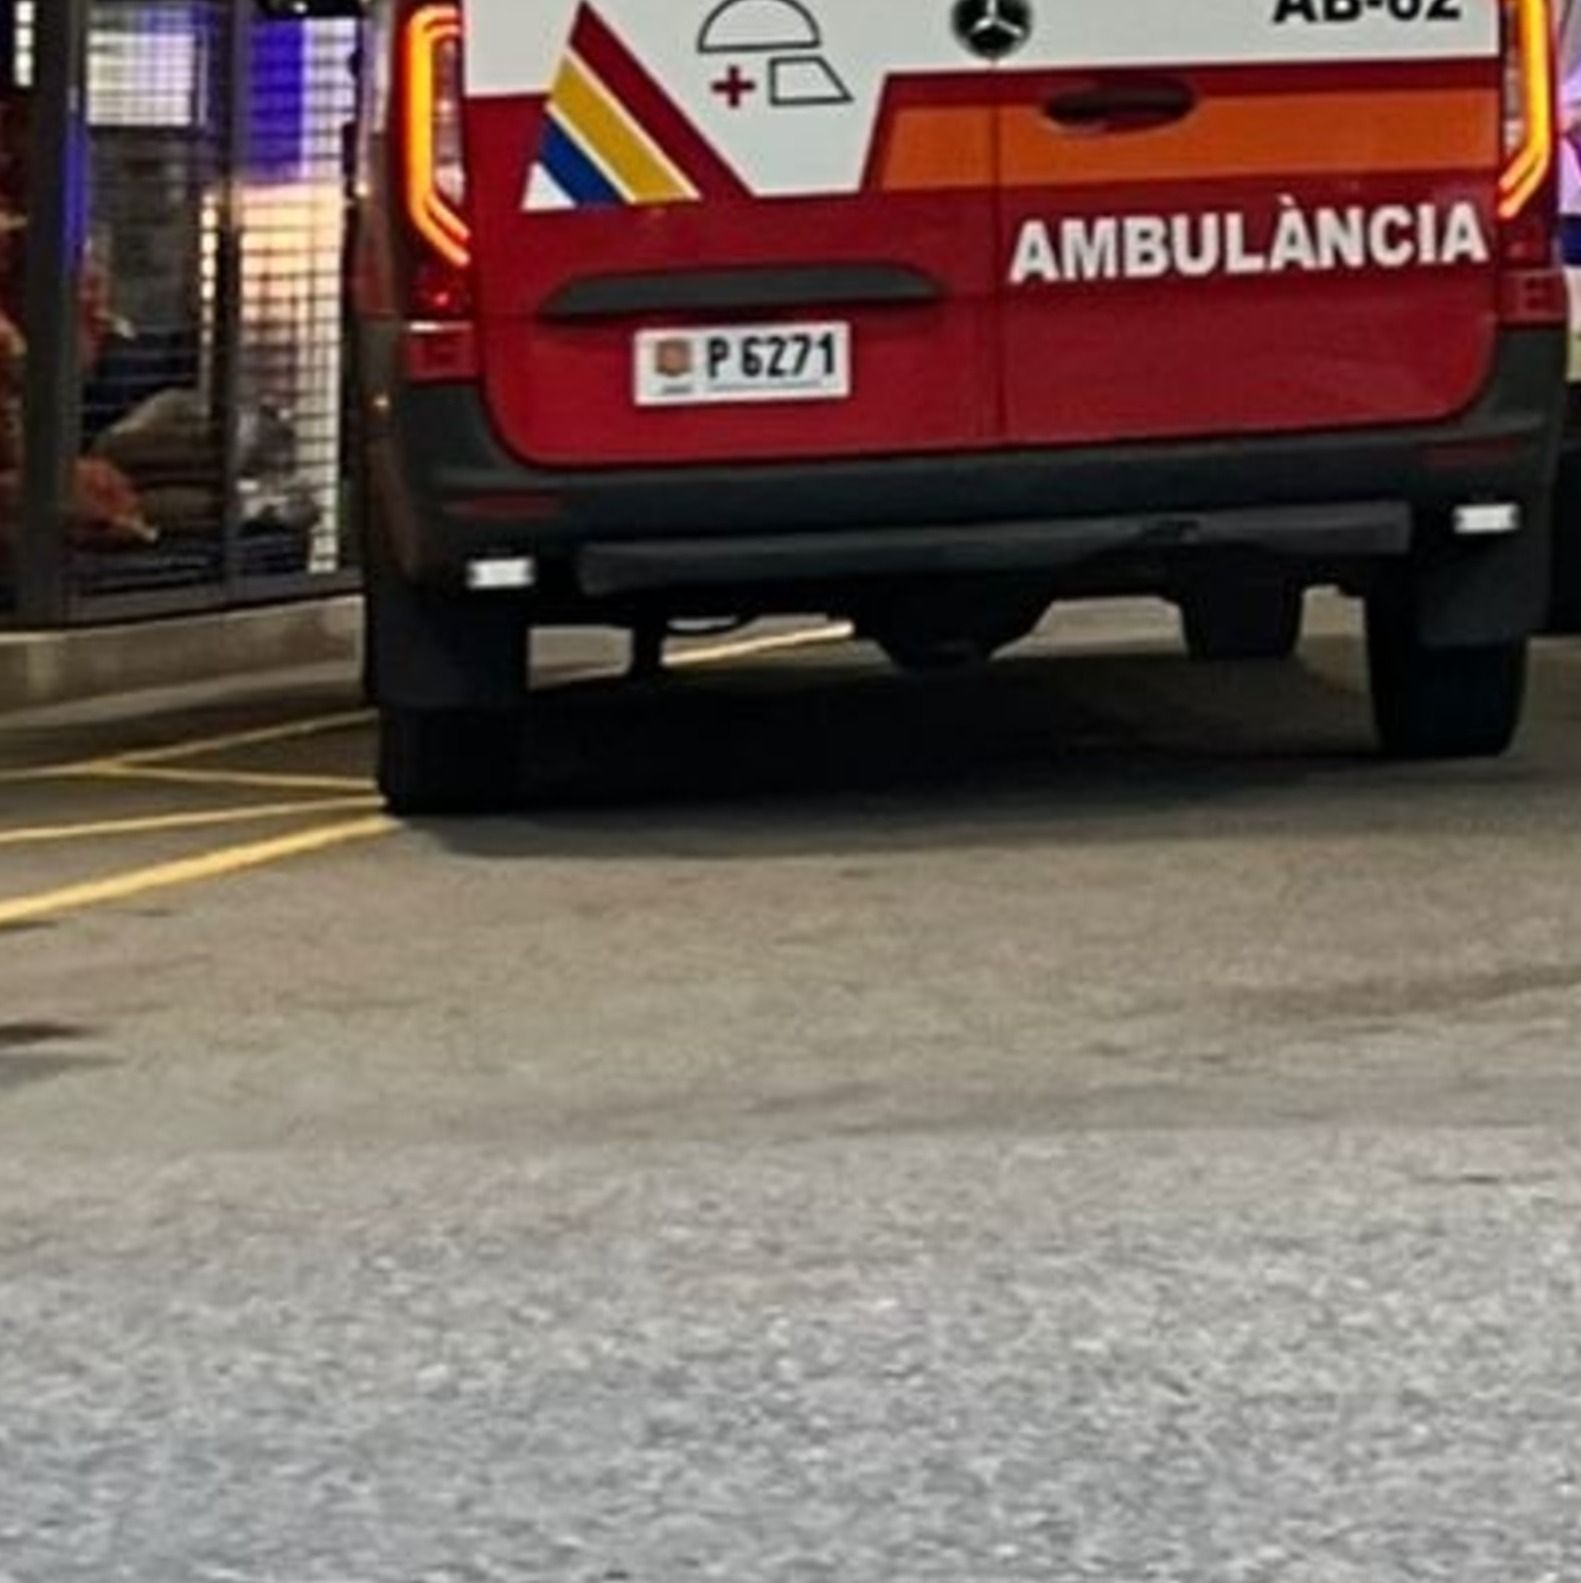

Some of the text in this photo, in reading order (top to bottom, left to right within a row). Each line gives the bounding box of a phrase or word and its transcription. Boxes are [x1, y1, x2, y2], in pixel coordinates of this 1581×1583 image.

[1009, 196, 1489, 284] AMBULÀNCIA
[708, 332, 834, 378] P 6271
